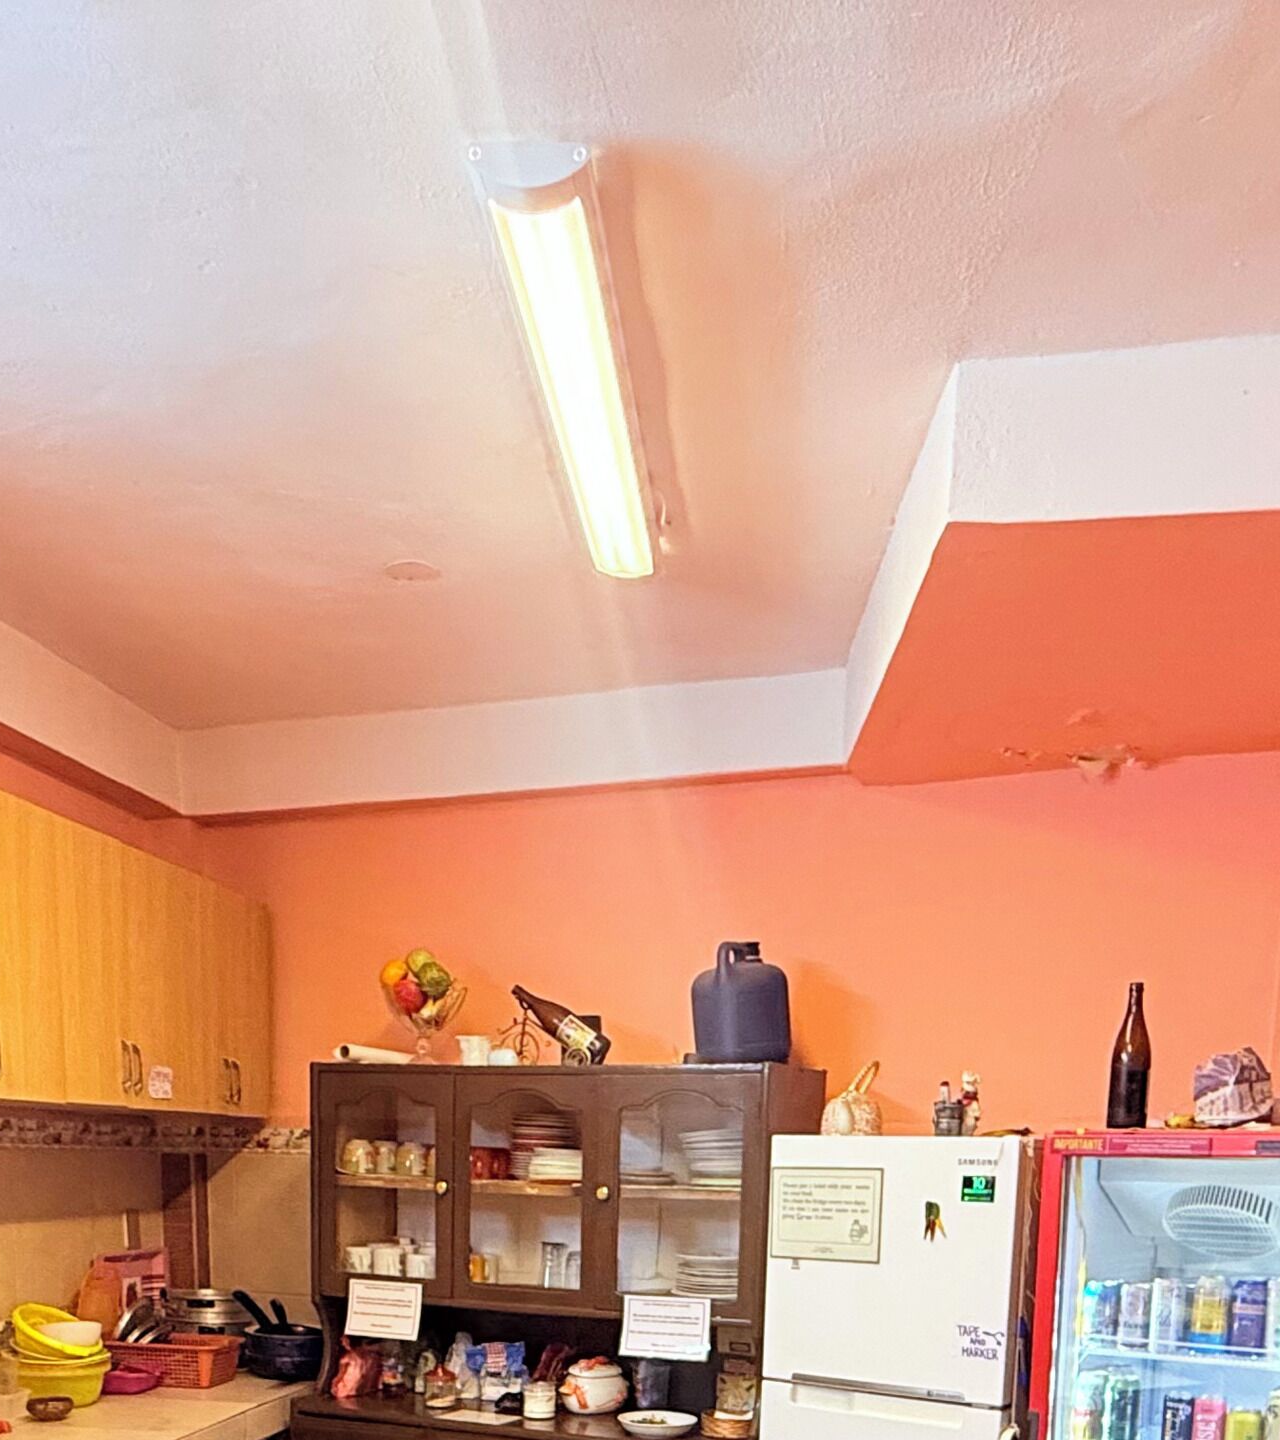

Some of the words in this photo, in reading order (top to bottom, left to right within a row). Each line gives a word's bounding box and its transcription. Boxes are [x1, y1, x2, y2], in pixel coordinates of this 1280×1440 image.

[1053, 1137, 1104, 1151] IMPORTANTE
[958, 1158, 999, 1166] SAMSUNG
[956, 1324, 980, 1338] TAPE
[970, 1337, 986, 1346] AND
[961, 1346, 999, 1361] MARKER
